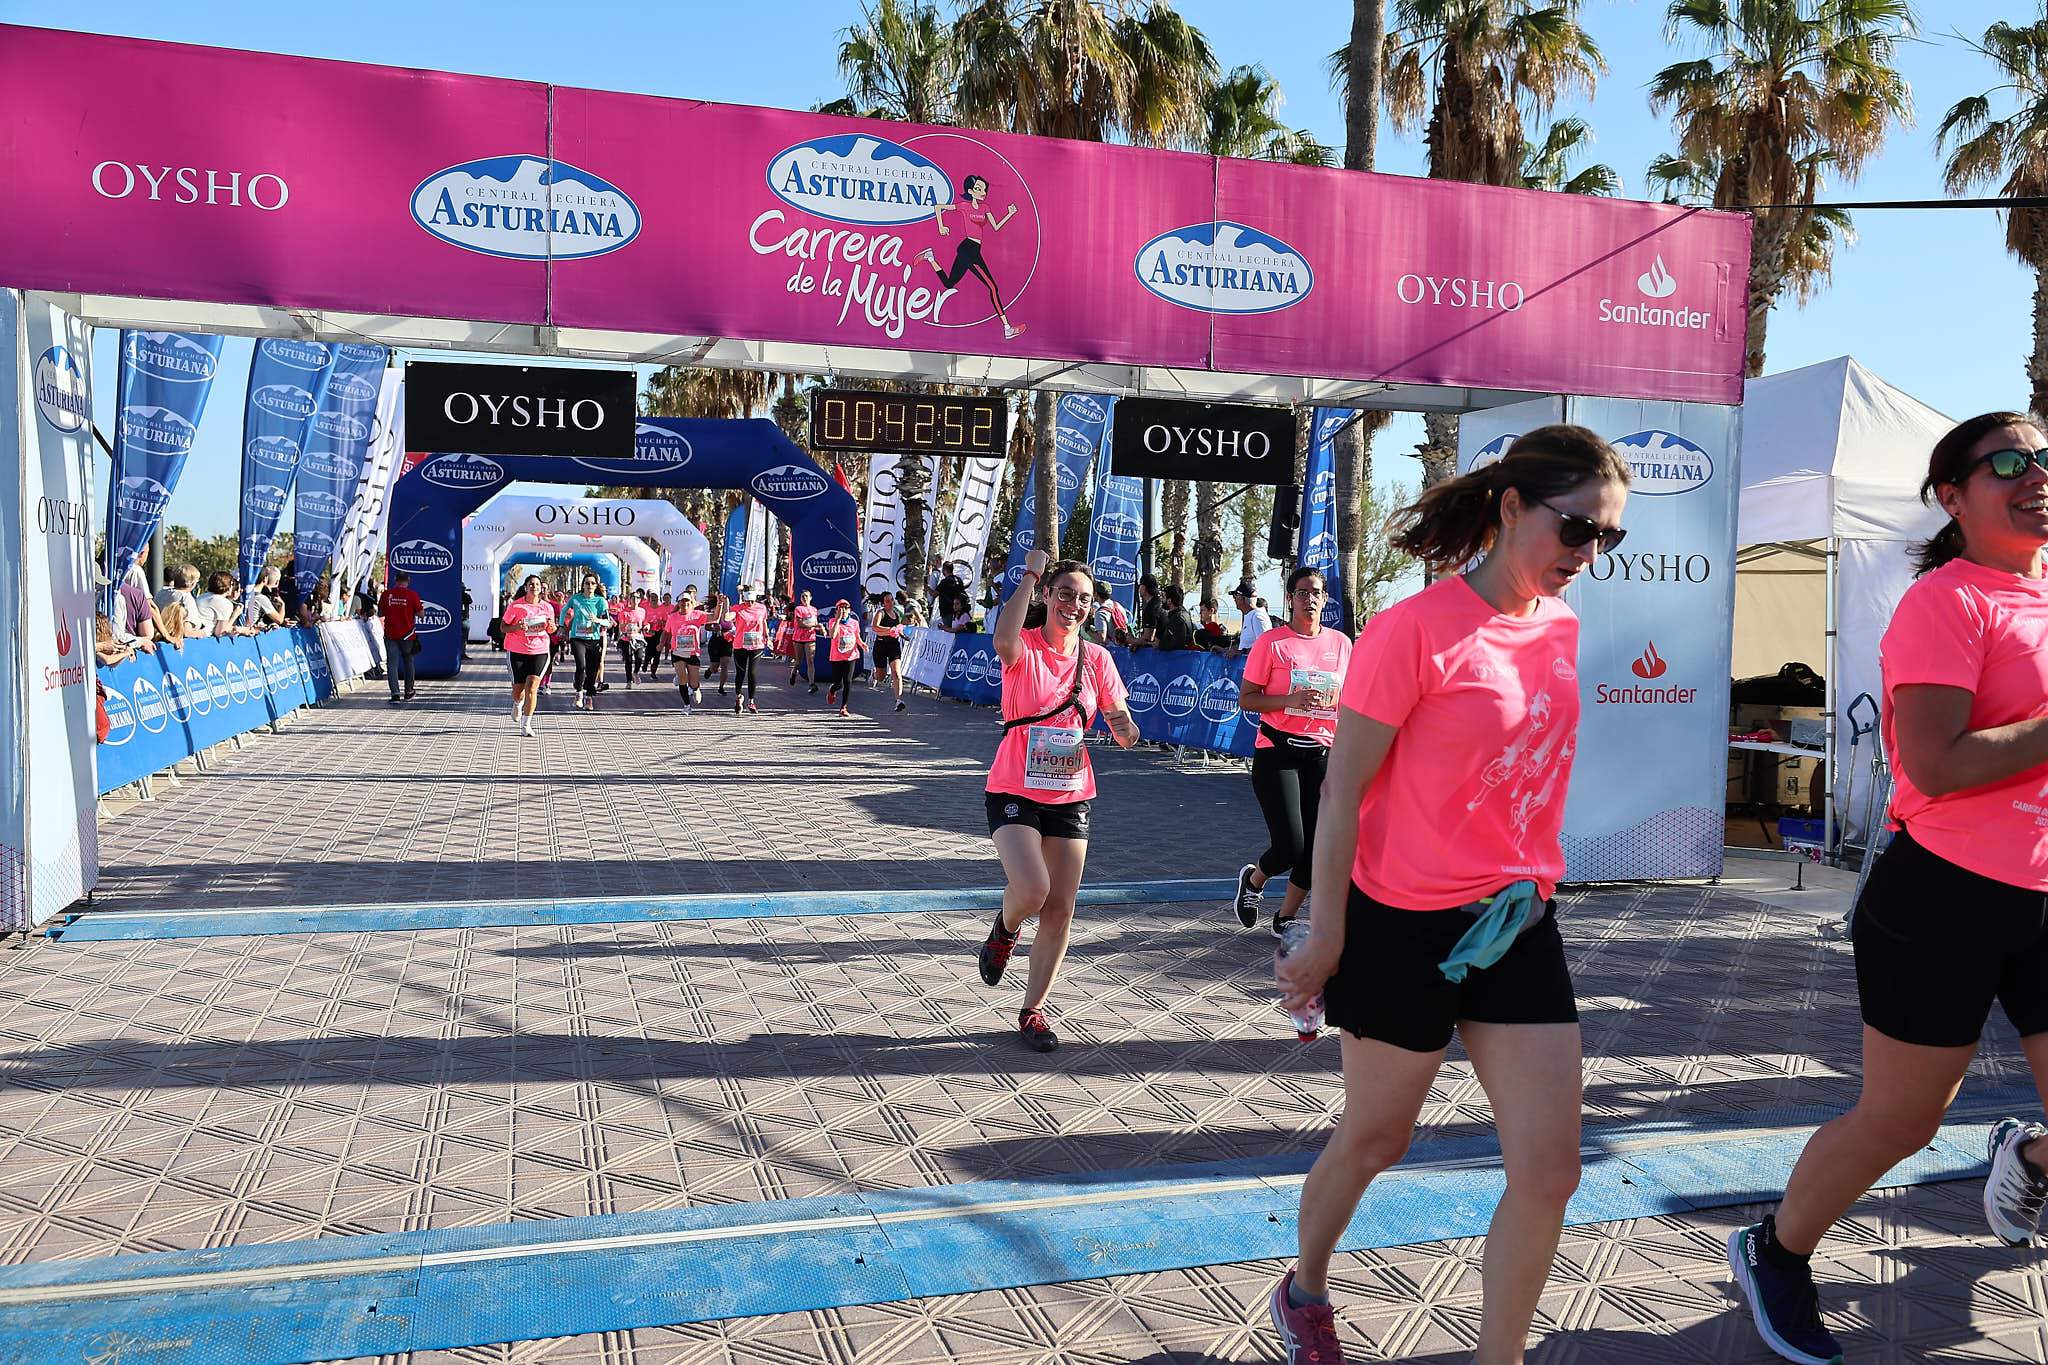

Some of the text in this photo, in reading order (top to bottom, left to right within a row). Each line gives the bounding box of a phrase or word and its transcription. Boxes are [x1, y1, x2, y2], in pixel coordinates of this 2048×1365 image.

[811, 160, 935, 181] CENTRAL LECHERA
[91, 160, 289, 211] OYSHO
[465, 186, 537, 202] CENTRAL
[781, 160, 938, 207] ASTURIANA
[428, 186, 624, 238] ASTURIANA
[749, 209, 903, 267] Carrera
[1177, 250, 1295, 268] CENTRAL LECHERA
[1149, 250, 1299, 294] ASTURIANA
[786, 262, 958, 339] de la Mujer
[1397, 273, 1525, 312] OYSHO
[1599, 298, 1711, 330] Santander
[125, 339, 210, 376] ASTURIANA
[37, 372, 86, 418] ASTURIANA
[329, 381, 371, 398] STURIANA
[444, 392, 605, 431] OYSHO
[825, 400, 992, 446] 00:42:52
[1056, 435, 1089, 454] STURIANA
[1144, 424, 1270, 459] OYSHO
[633, 446, 682, 462] RIANA
[1663, 453, 1702, 461] LECHERA
[427, 464, 497, 481] ASTURIANA
[1630, 461, 1704, 481] TURIANA
[758, 479, 823, 491] ASTURIANA
[38, 496, 88, 538] OYSHO
[535, 504, 636, 527] OYSHO
[473, 525, 505, 533] OYSHO
[663, 528, 692, 536] OYSHO
[393, 551, 449, 566] ASTURIANA
[728, 531, 745, 574] Marlene
[805, 565, 857, 575] ASTURIANA
[1589, 554, 1710, 583] OYSHO
[415, 616, 447, 626] RIANA
[44, 664, 86, 692] Santander
[1163, 690, 1195, 707] ASTURIANA
[1201, 692, 1238, 712] ASTURIANA
[1596, 684, 1696, 704] Santander
[1747, 1233, 1758, 1267] HOKA
